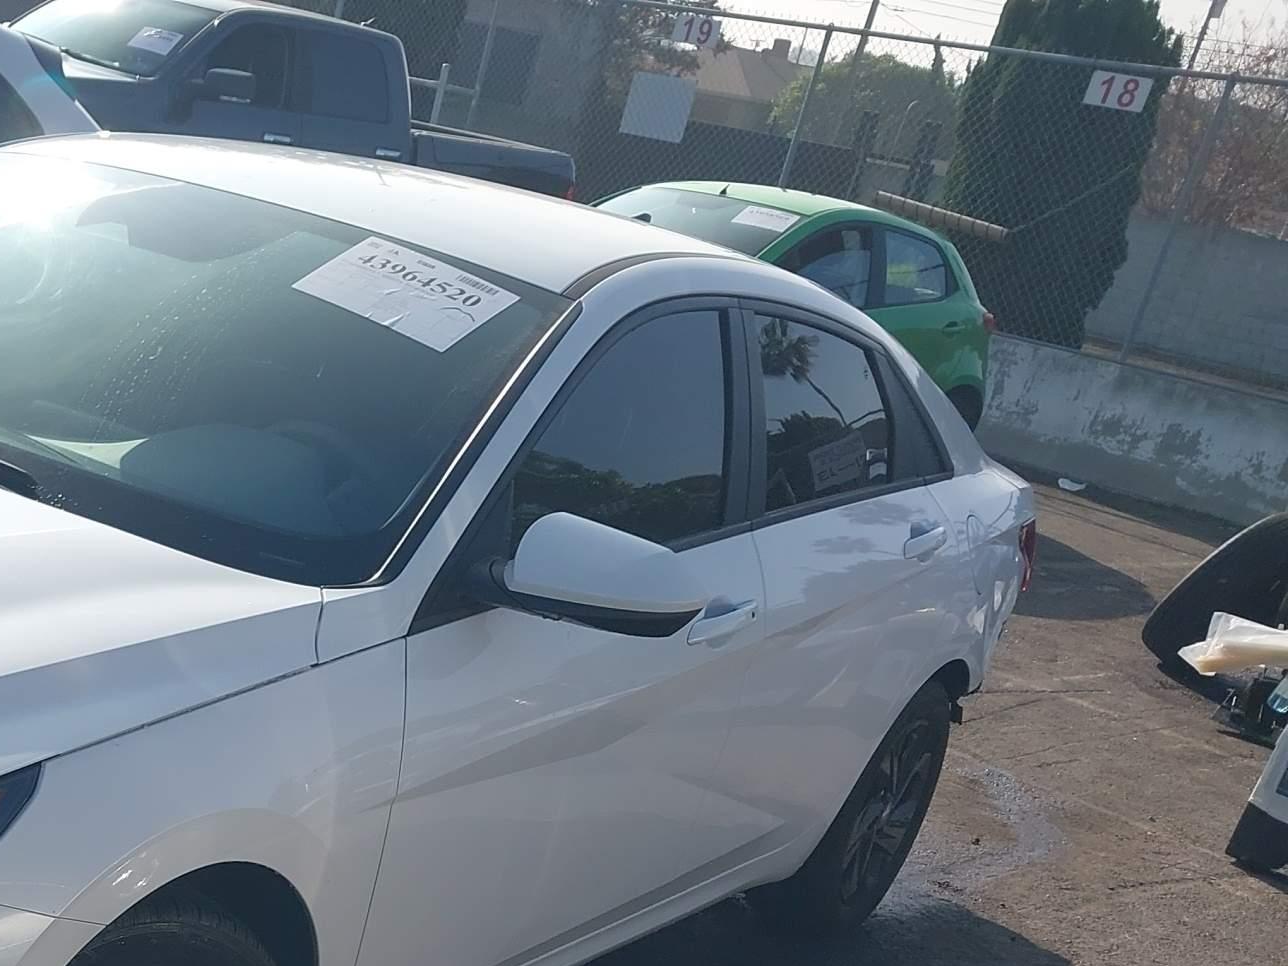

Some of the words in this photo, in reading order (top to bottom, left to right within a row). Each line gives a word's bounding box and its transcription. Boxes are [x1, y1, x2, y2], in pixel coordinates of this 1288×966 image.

[683, 16, 712, 45] 19
[1100, 75, 1140, 107] 18
[358, 254, 482, 307] 43964520
